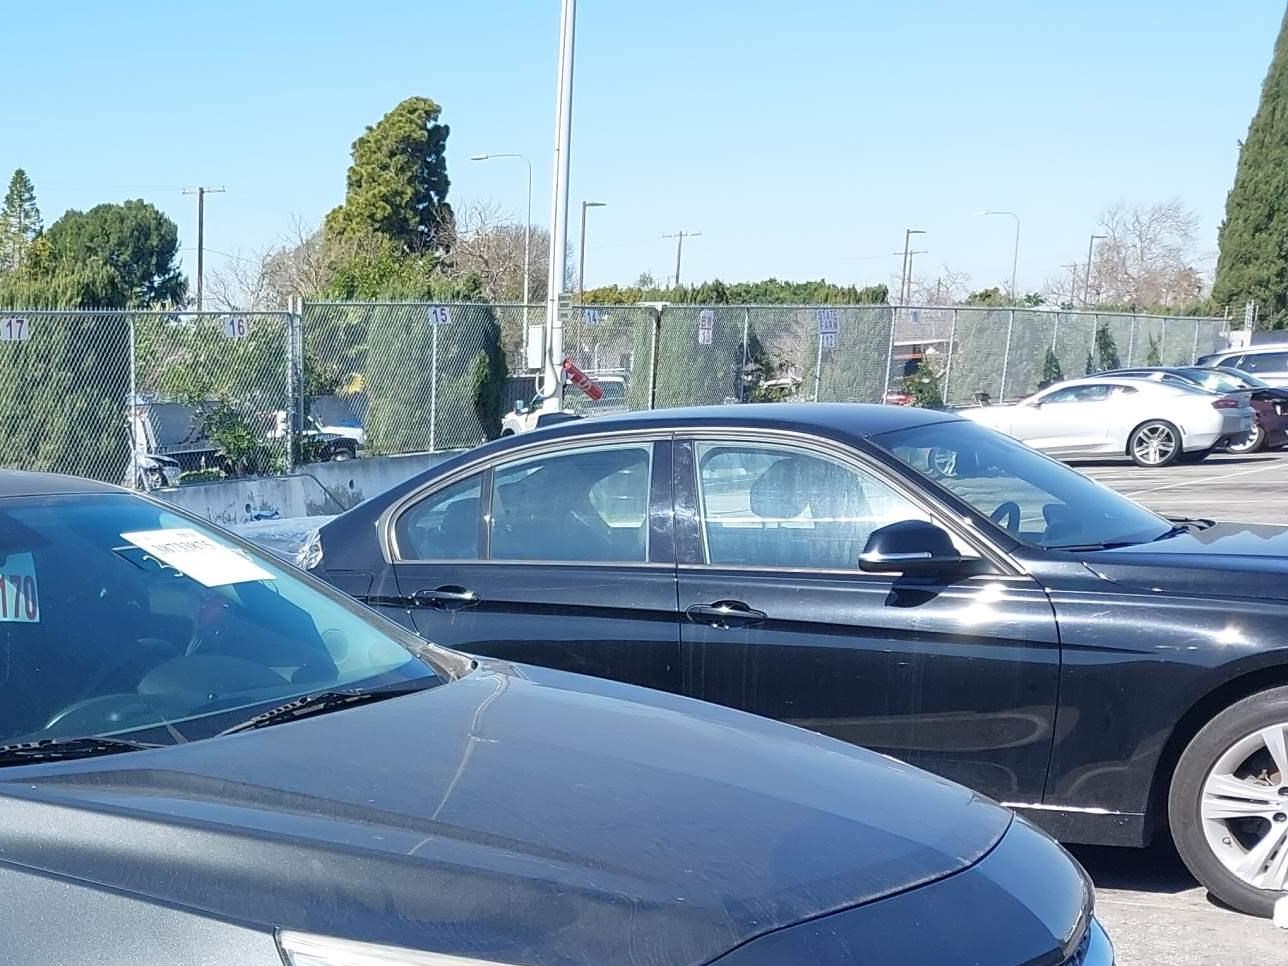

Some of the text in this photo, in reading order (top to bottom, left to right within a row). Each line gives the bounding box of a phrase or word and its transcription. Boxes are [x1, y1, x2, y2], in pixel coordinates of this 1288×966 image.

[432, 307, 448, 324] 15
[817, 310, 838, 320] STATE
[5, 319, 25, 339] 17
[229, 318, 245, 337] 16
